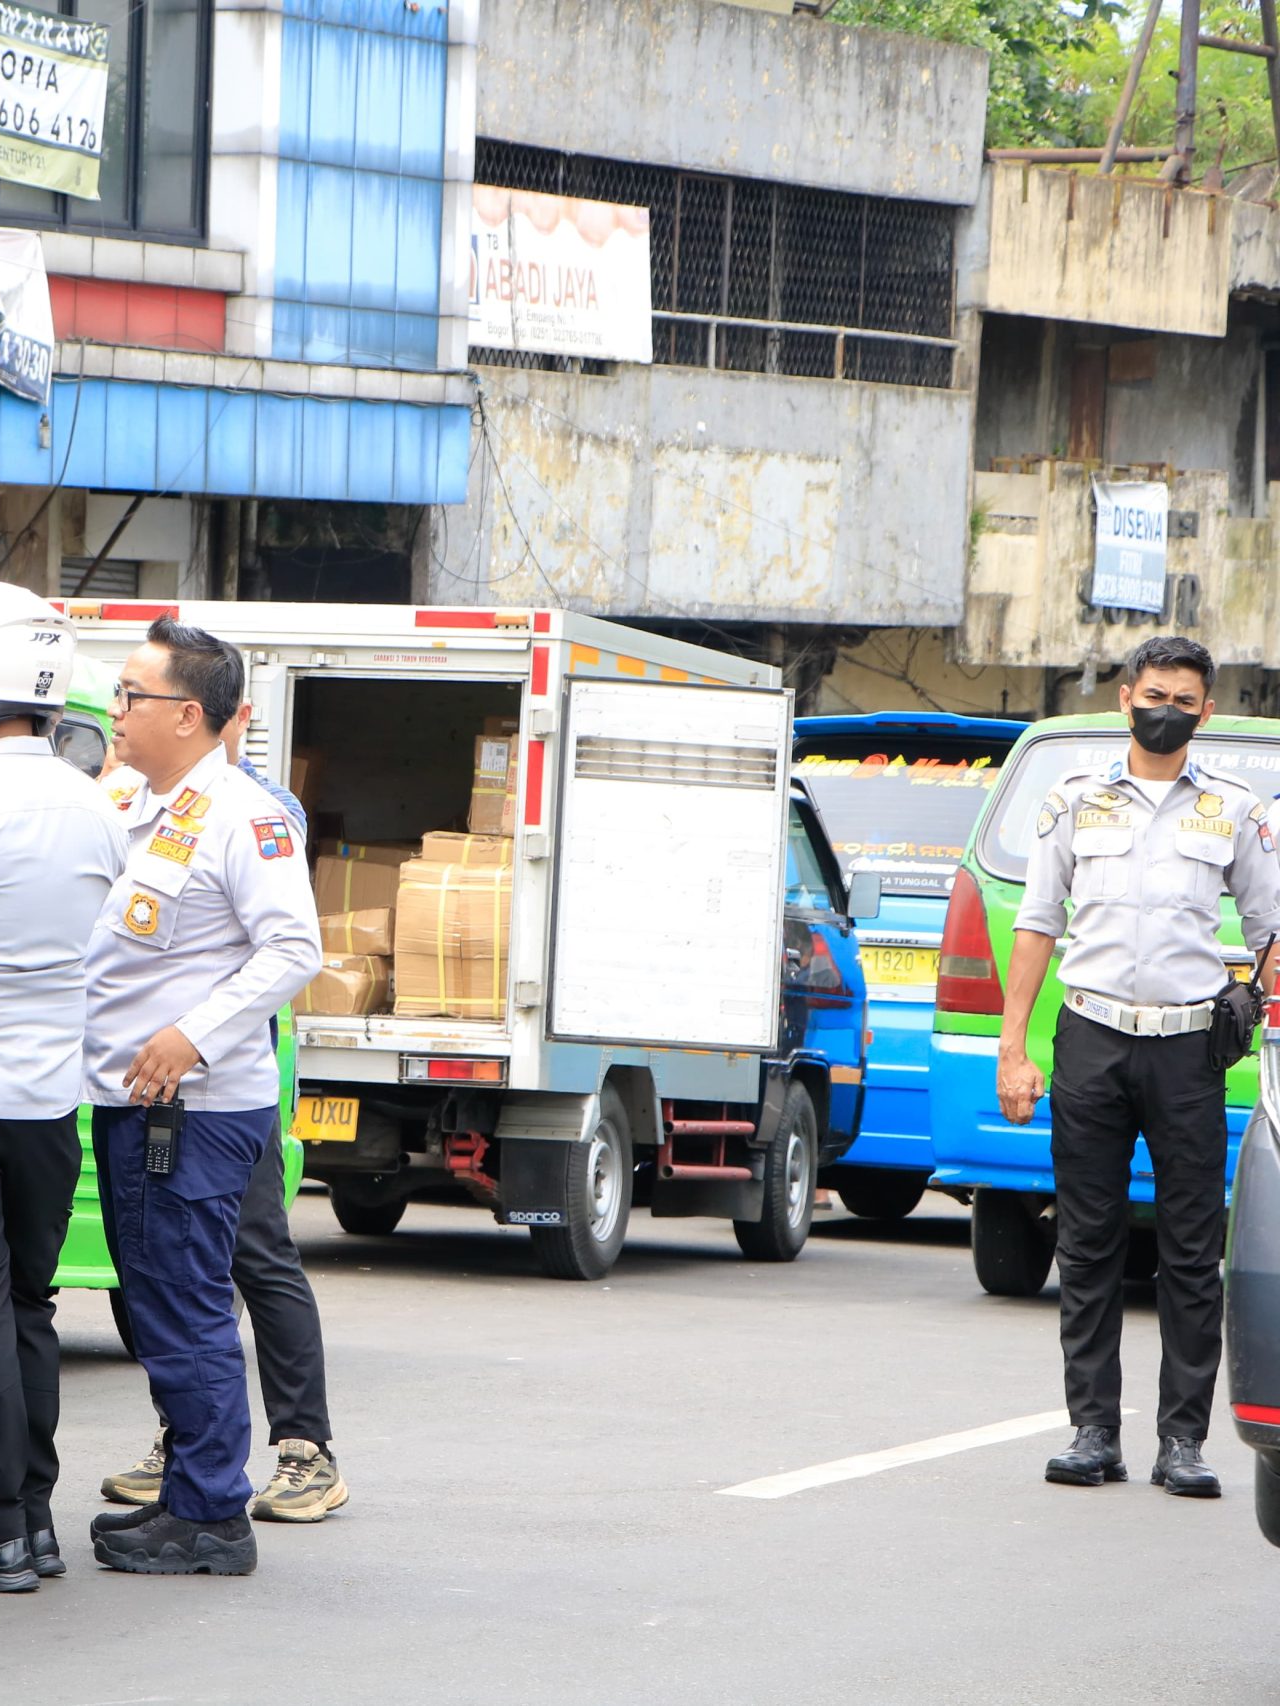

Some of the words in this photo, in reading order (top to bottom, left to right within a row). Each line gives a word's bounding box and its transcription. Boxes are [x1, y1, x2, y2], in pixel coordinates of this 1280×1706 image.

[51, 113, 96, 150] 4126
[485, 257, 547, 305] ABADI
[553, 264, 599, 310] JAYA
[487, 321, 510, 338] Bogor
[29, 632, 61, 646] JPX
[1180, 817, 1232, 836] DISHUB
[151, 839, 190, 860] DISHUB
[894, 877, 941, 887] TUNGGAL
[874, 950, 914, 971] 1920
[509, 1211, 560, 1222] sparco
